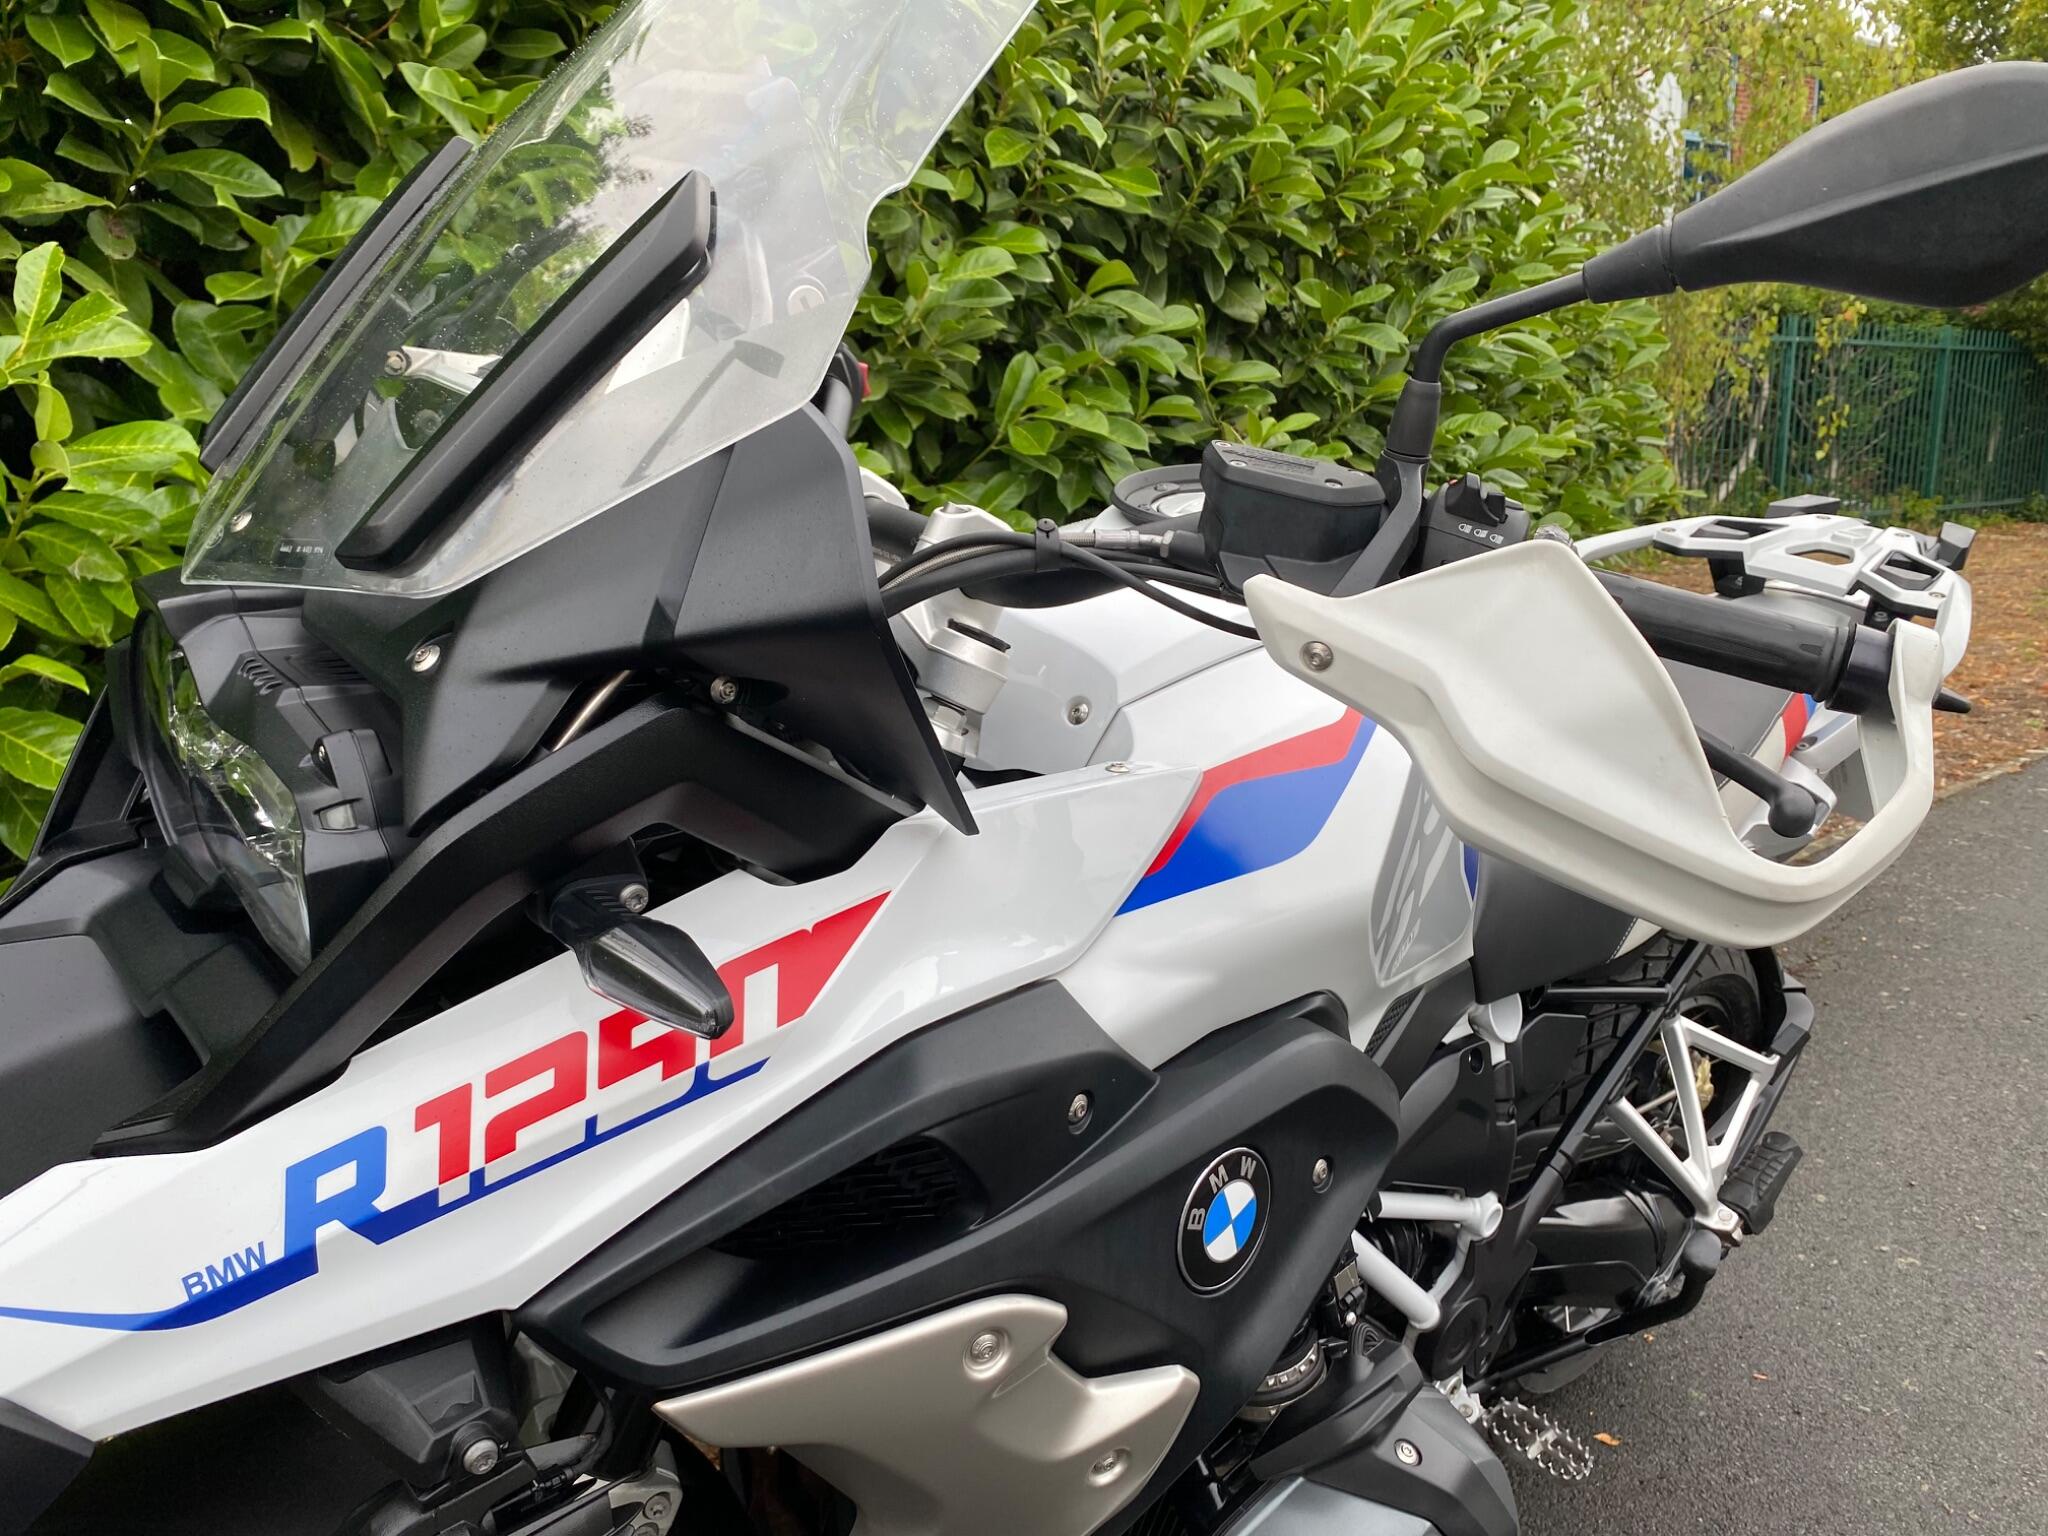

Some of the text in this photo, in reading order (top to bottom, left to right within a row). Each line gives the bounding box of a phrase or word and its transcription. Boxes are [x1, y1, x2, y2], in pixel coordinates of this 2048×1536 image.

[182, 1241, 267, 1300] BMW
[284, 1125, 390, 1273] R
[1187, 1155, 1257, 1231] BMW
